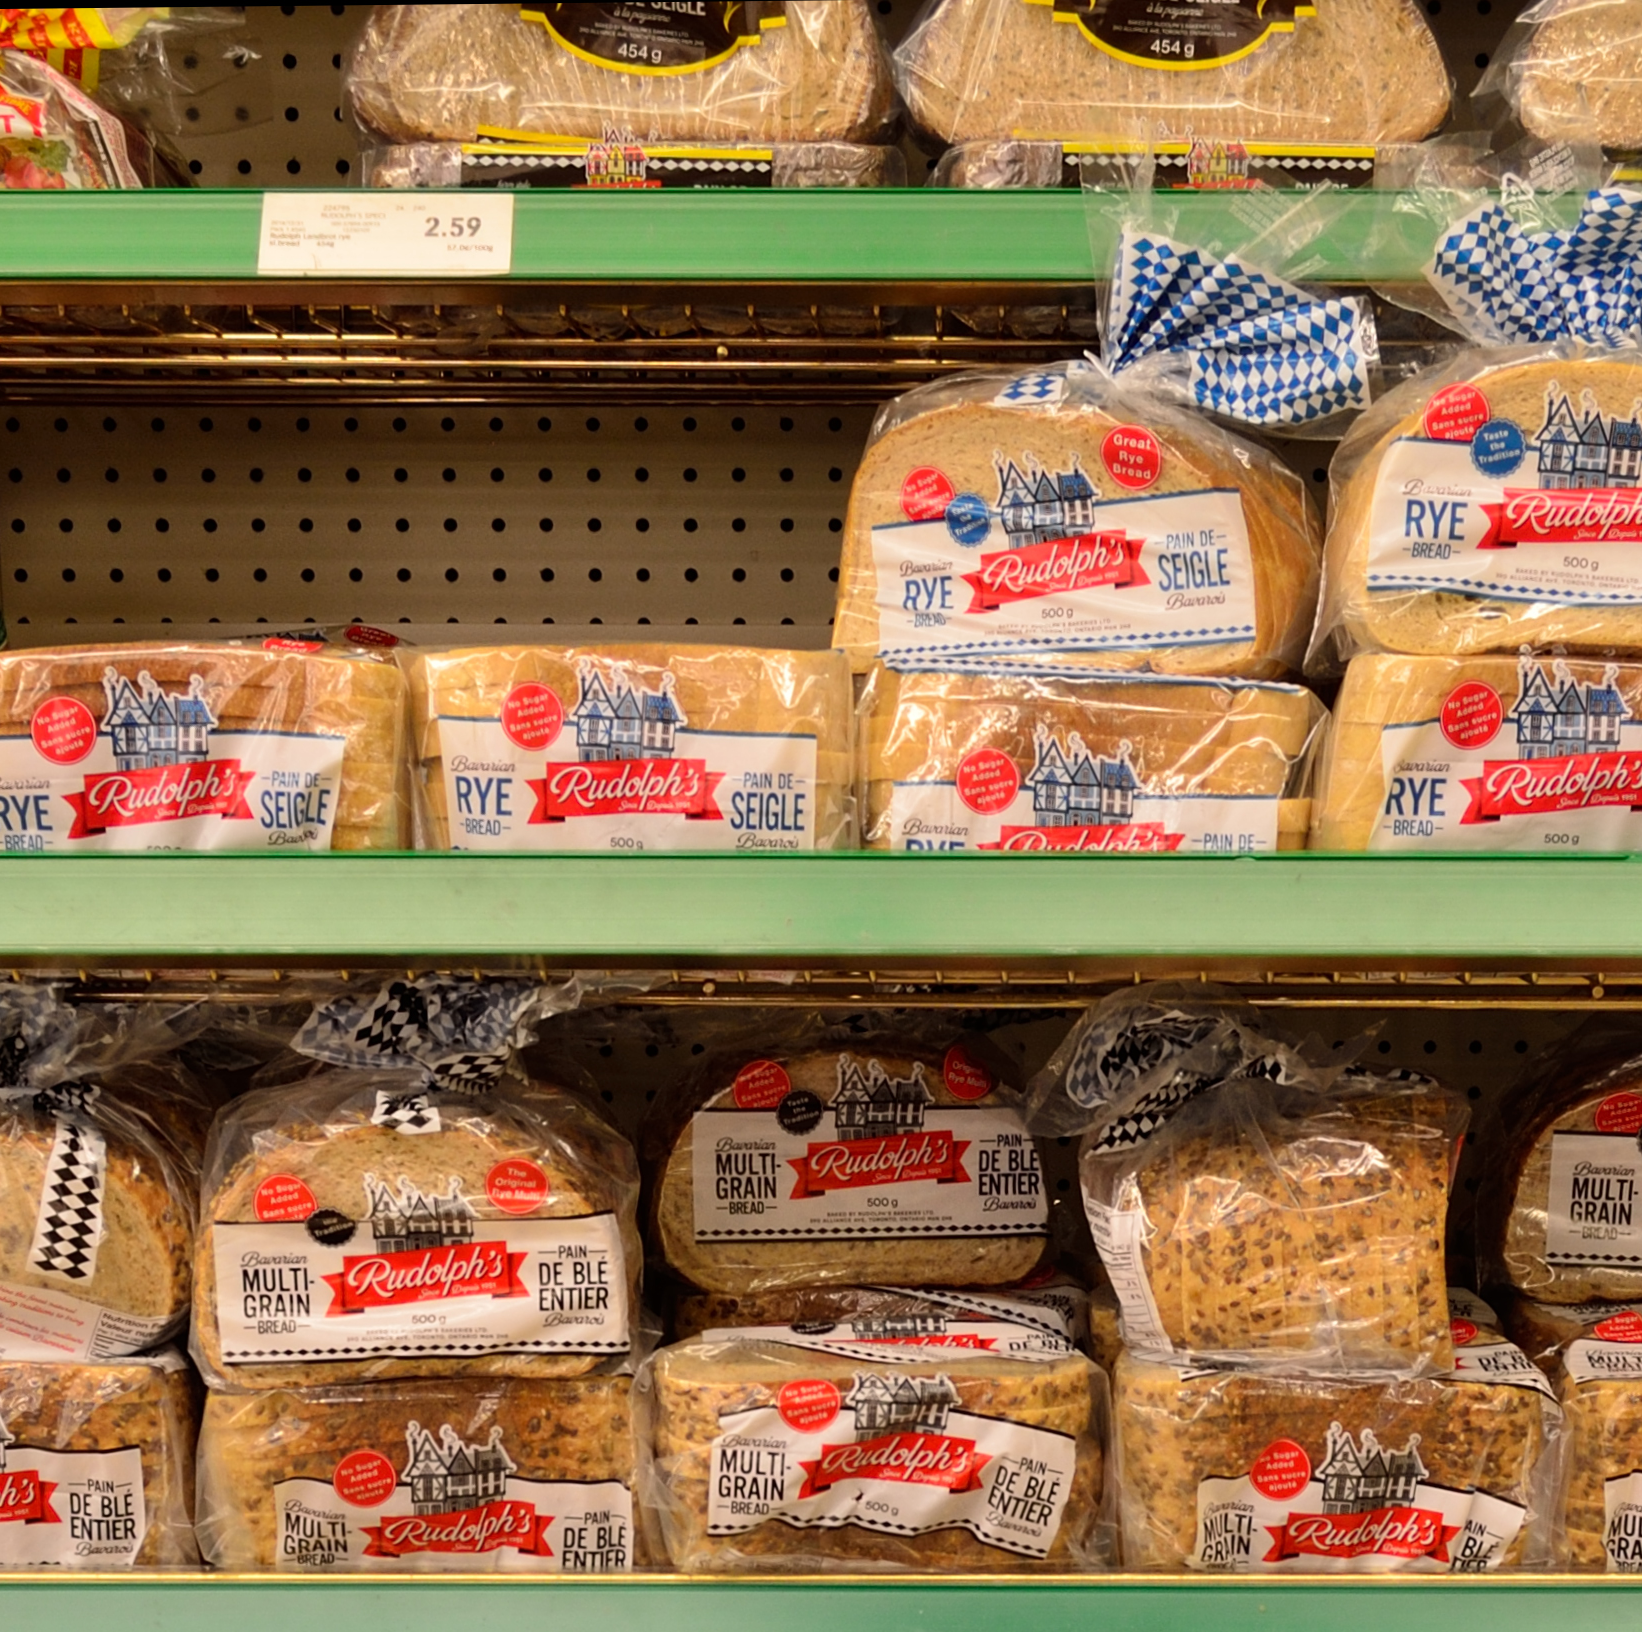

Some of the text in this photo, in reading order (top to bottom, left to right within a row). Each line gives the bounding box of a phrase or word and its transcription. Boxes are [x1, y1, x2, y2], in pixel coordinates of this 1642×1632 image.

[618, 43, 661, 63] 454 g
[425, 217, 481, 237] 2.59
[982, 539, 1125, 591] Rudolph's
[1159, 549, 1229, 591] SEIGLE
[90, 766, 239, 815] Rudolph's
[550, 765, 699, 807] Rudolph's
[730, 792, 805, 832] SEIGLE
[813, 1135, 947, 1179] Rudolph's
[242, 1266, 315, 1293] MULTI-
[348, 1247, 504, 1294] Rudolph's
[538, 1256, 608, 1286] DE BLÉ
[243, 1291, 310, 1318] GRAIN
[539, 1285, 610, 1311] ENTIER
[412, 1314, 446, 1328] 500 g
[1289, 1511, 1437, 1554] Rudolph's
